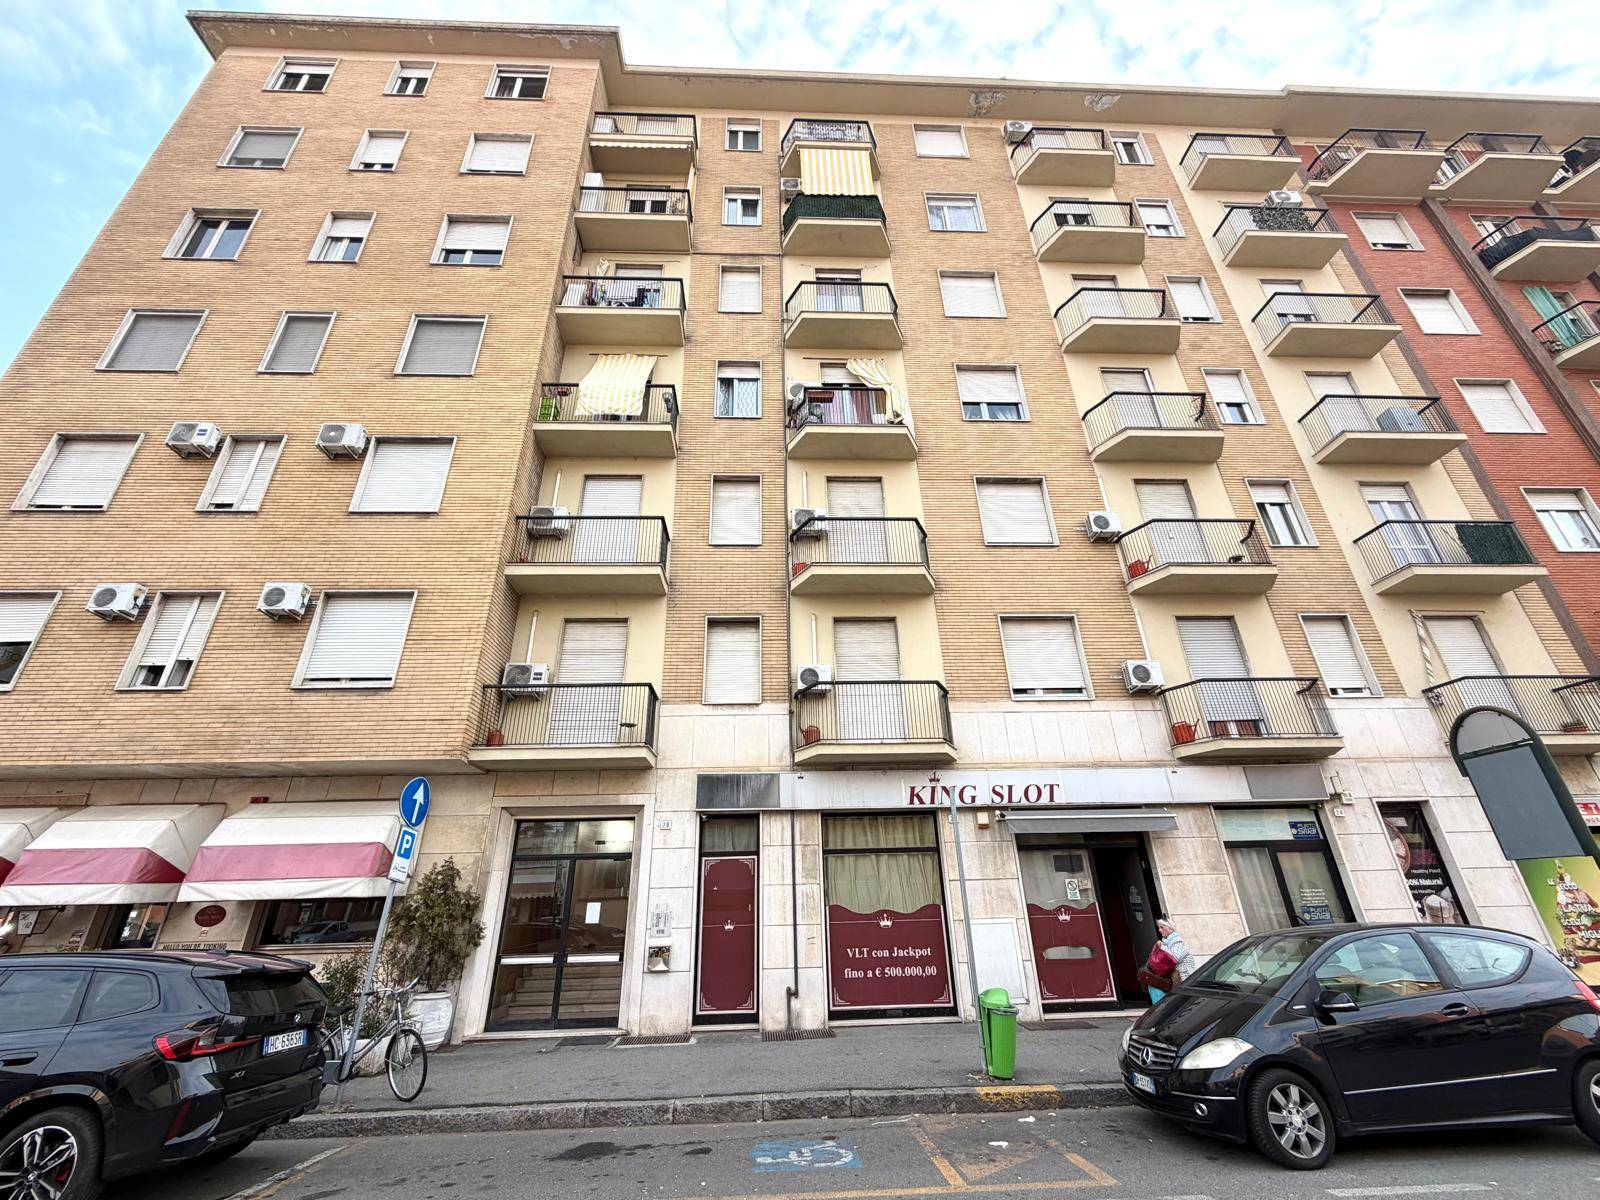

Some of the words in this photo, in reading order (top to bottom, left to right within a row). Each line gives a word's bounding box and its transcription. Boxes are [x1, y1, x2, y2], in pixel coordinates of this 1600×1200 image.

[908, 785, 977, 805] KING
[991, 784, 1059, 804] SLOT
[401, 834, 412, 854] P
[1562, 904, 1575, 912] LA
[1575, 904, 1596, 912] TUA
[846, 947, 869, 958] VLT
[872, 948, 889, 958] con
[892, 946, 931, 959] Jackpot
[844, 968, 864, 978] fino
[867, 970, 873, 978] a
[875, 967, 882, 977] €
[884, 966, 937, 978] 500.000,00
